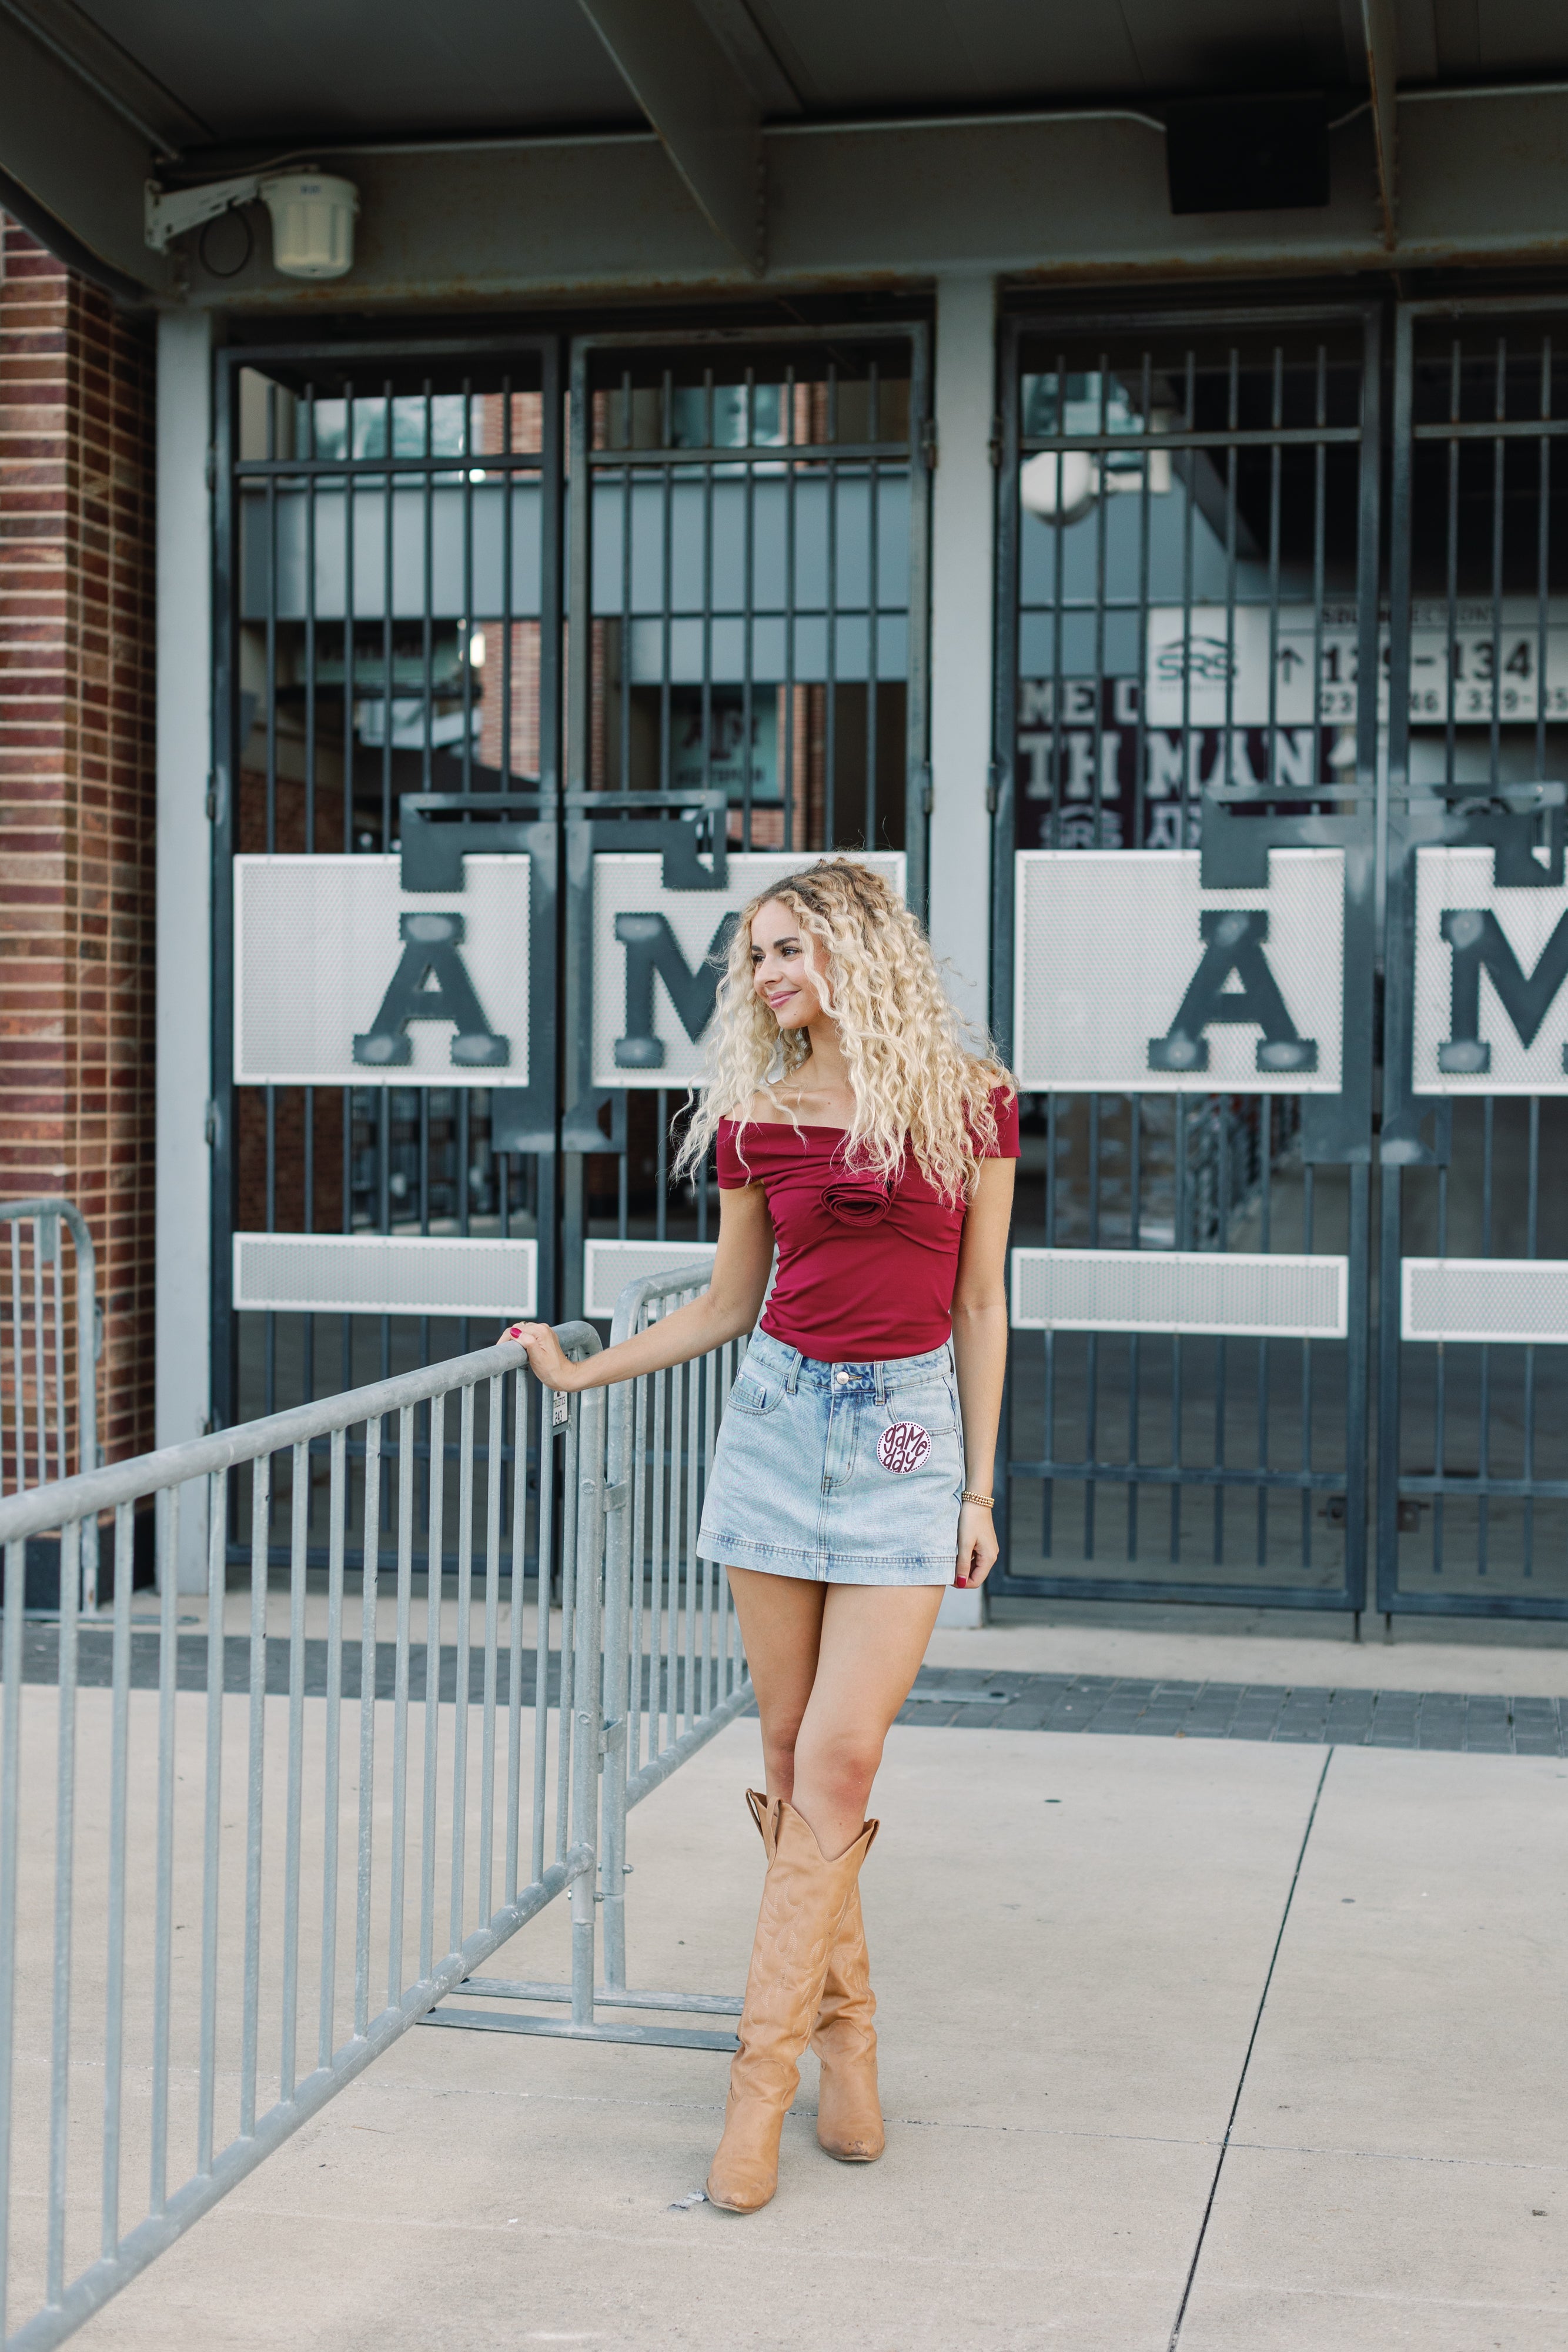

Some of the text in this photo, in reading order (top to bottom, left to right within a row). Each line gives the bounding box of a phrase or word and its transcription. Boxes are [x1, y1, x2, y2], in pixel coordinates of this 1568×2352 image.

[1158, 653, 1239, 681] SRS
[1145, 730, 1316, 800] MAN
[553, 1396, 566, 1408] THLETICS
[883, 1448, 917, 1473] day
